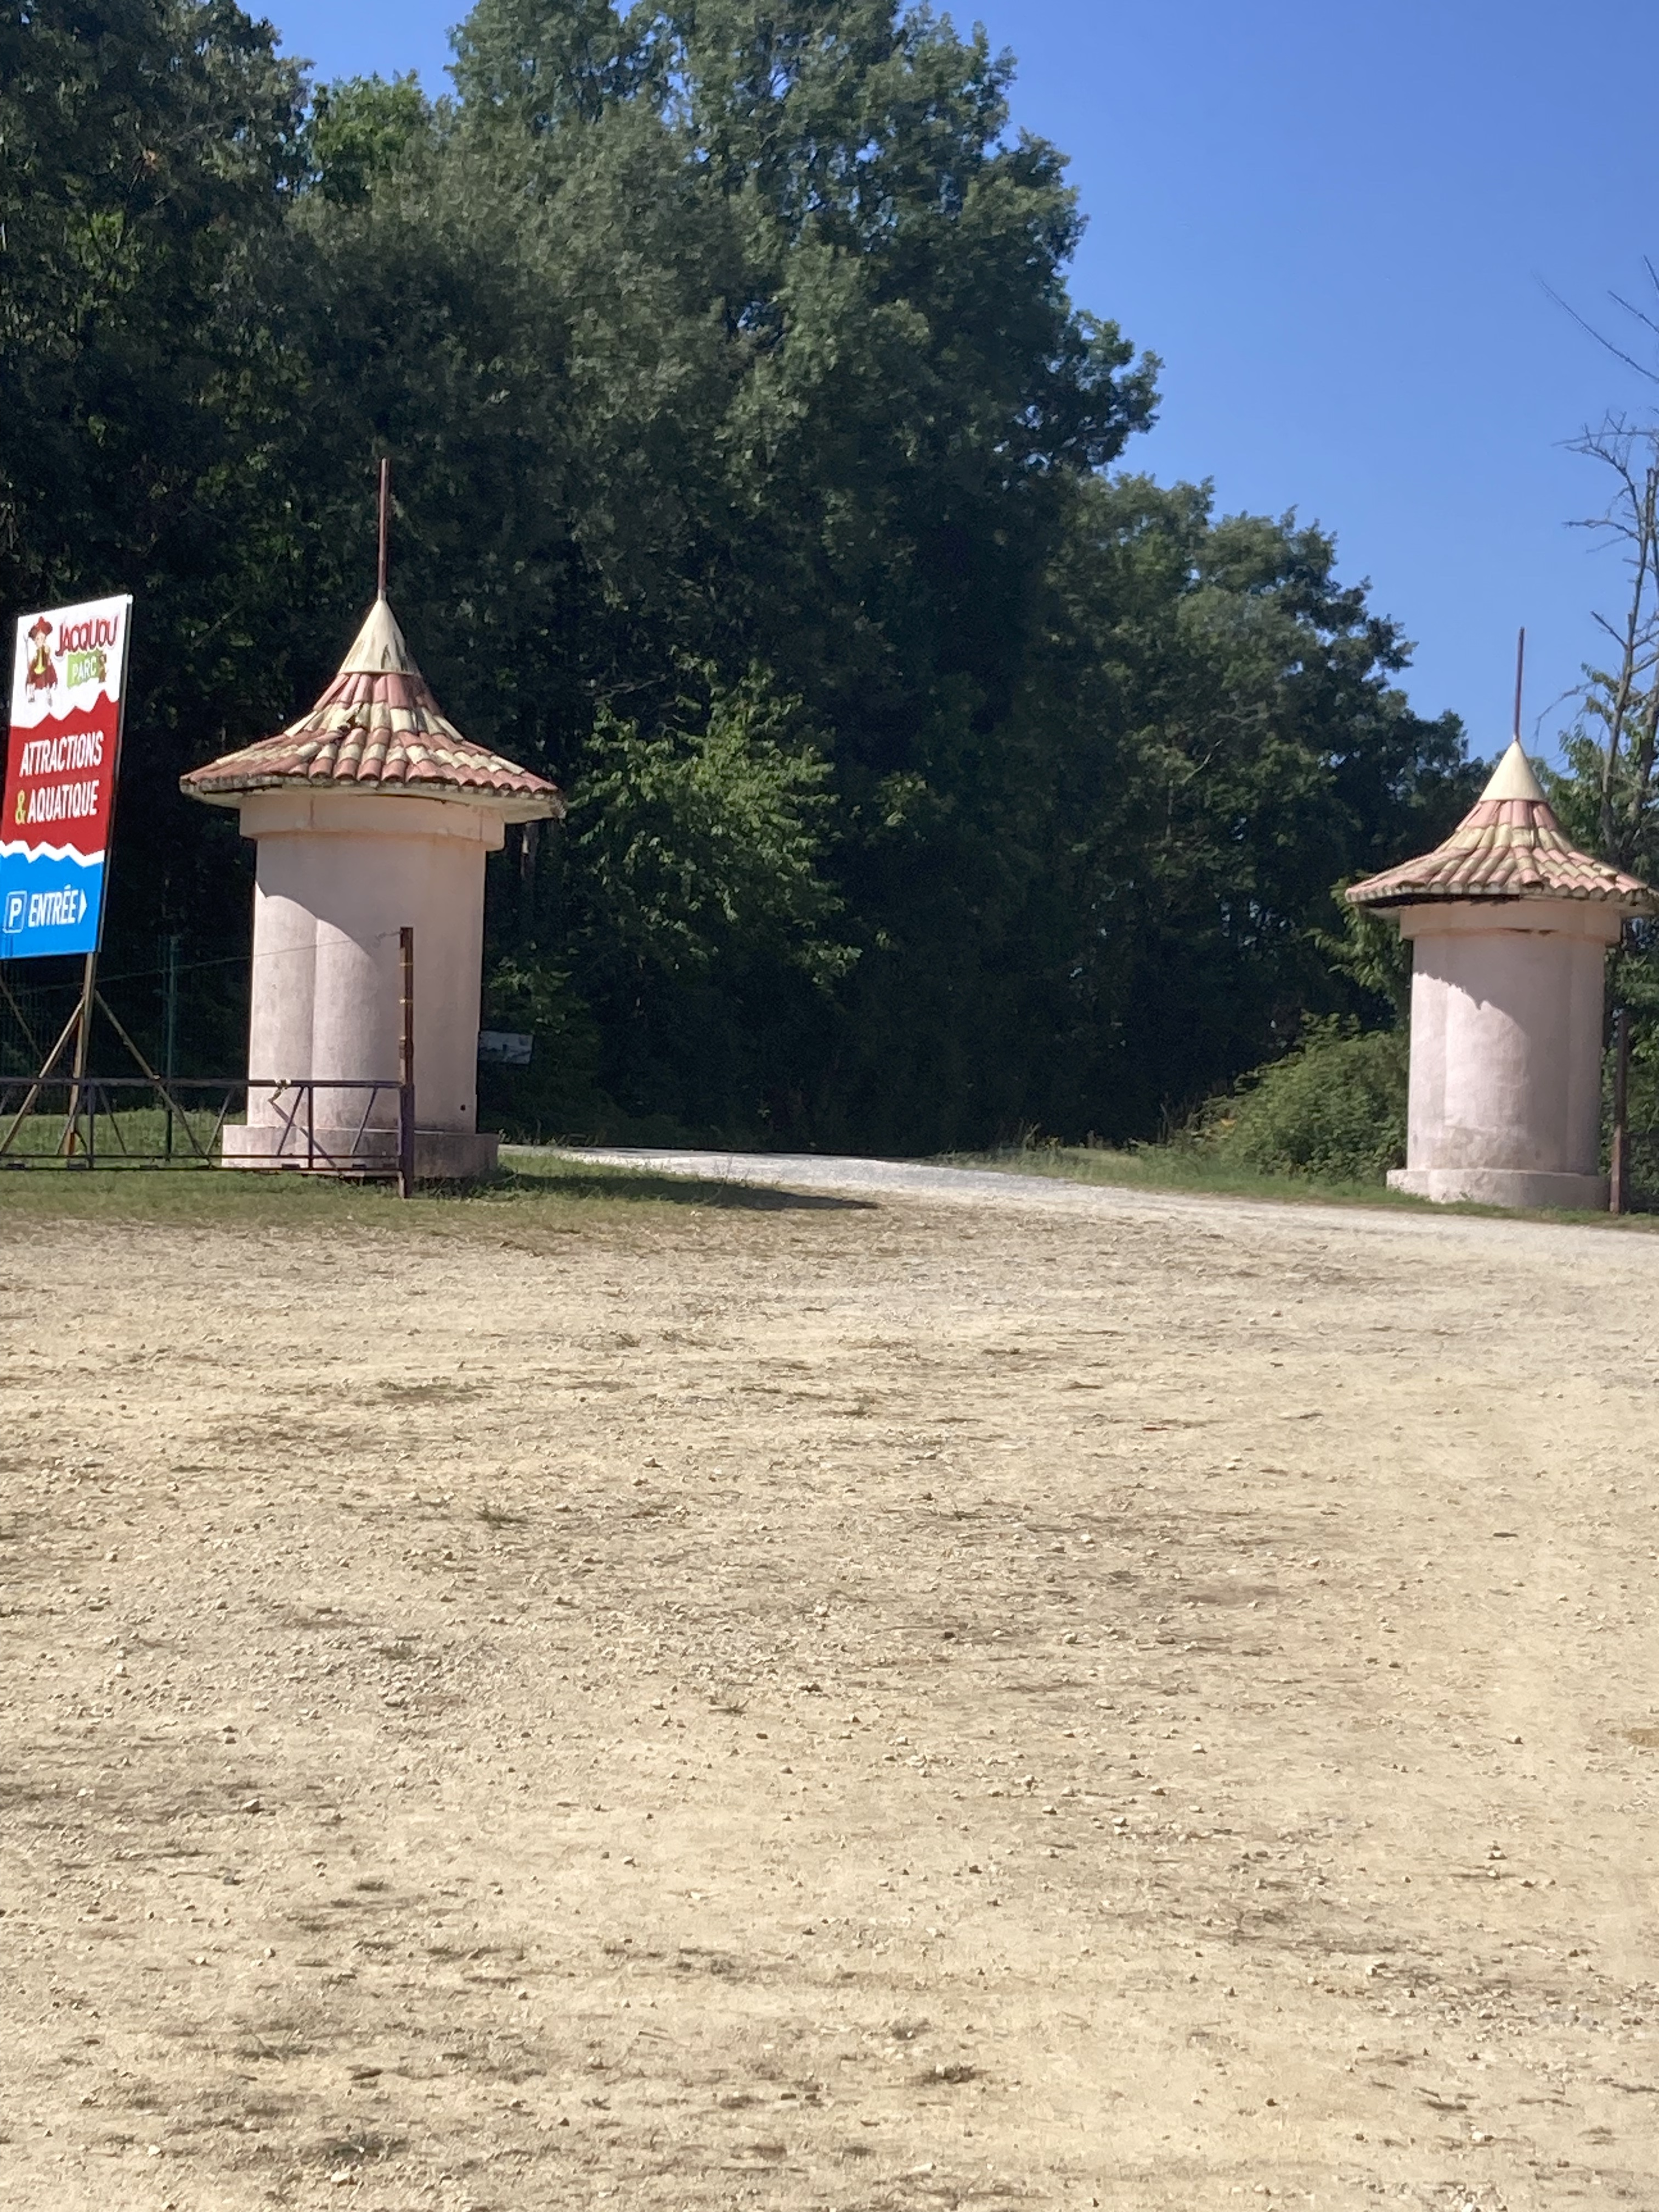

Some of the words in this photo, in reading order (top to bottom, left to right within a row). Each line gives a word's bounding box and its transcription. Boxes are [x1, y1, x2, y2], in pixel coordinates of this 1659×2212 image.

[55, 615, 119, 657] JACQUOU
[72, 656, 97, 678] PARC
[19, 730, 104, 778] ATTRACTIONS
[15, 789, 26, 825] &
[27, 779, 99, 824] AQUATIQUE
[28, 884, 78, 927] ENTRÉE
